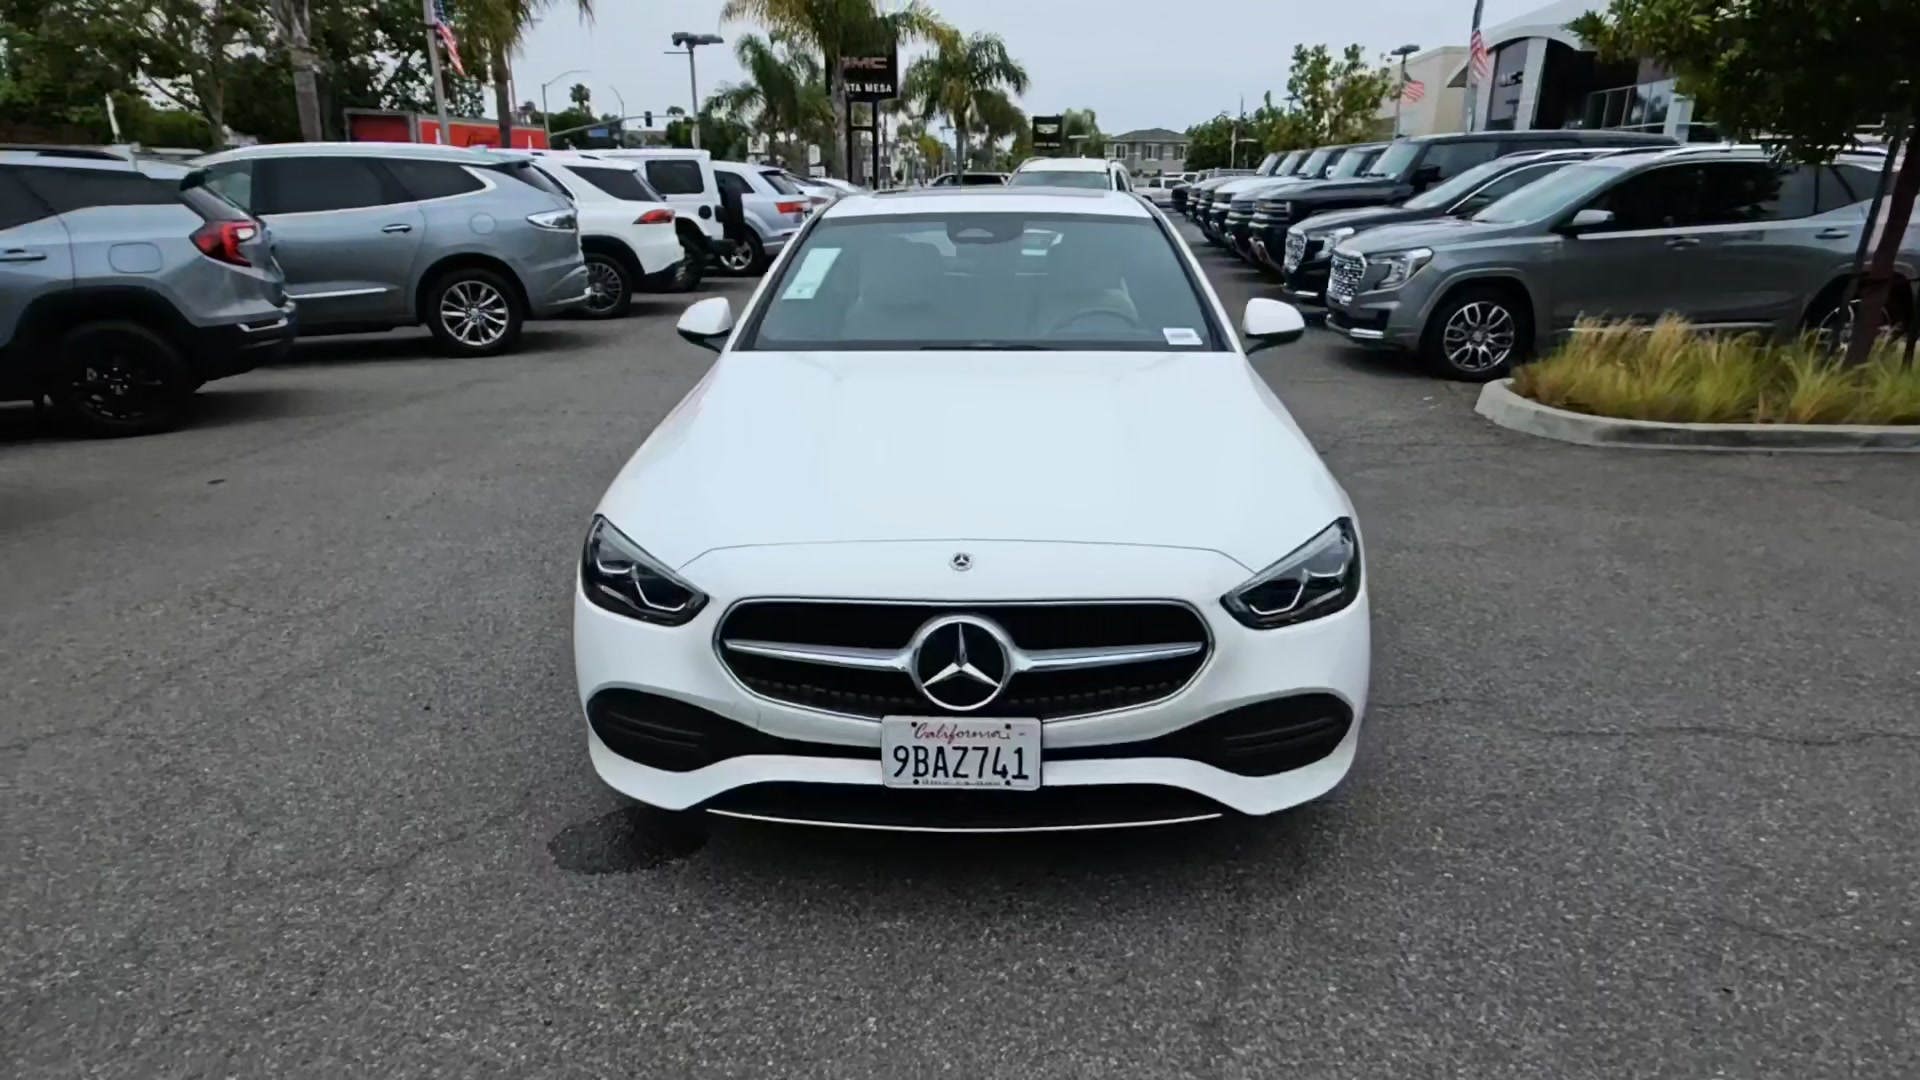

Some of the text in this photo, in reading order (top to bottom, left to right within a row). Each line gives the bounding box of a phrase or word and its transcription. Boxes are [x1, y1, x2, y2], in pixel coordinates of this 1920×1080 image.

[864, 83, 892, 93] MESA
[914, 722, 1010, 744] California
[893, 745, 1029, 780] 9BAZ741
